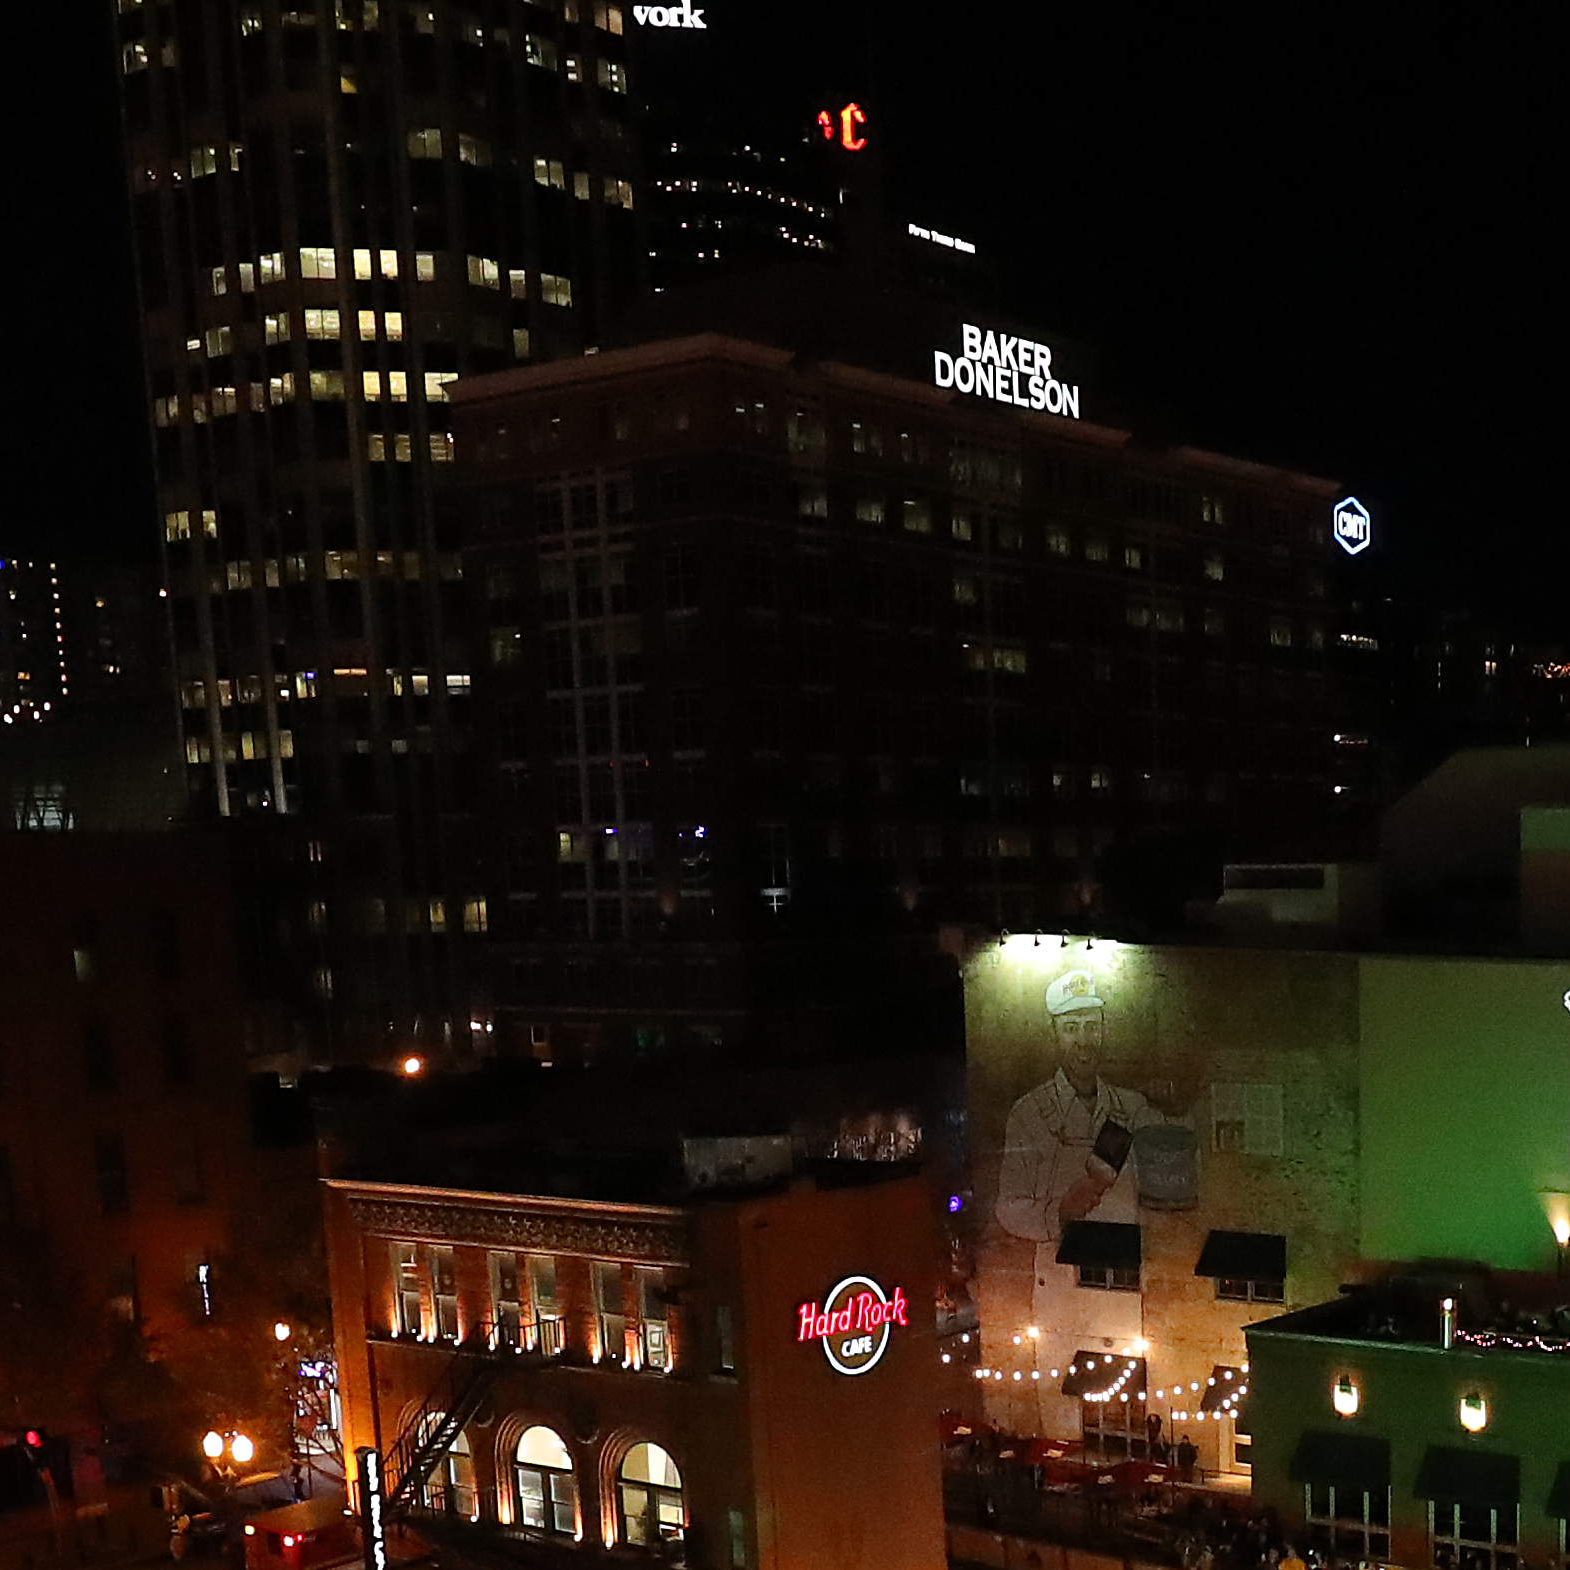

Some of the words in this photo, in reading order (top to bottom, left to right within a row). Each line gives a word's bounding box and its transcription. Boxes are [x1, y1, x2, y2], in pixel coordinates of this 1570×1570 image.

[962, 323, 1053, 380] BAKER
[934, 350, 1080, 419] DONELSON
[1338, 511, 1367, 540] CMT
[798, 1297, 853, 1342] Hard
[855, 1287, 910, 1332] Rock
[841, 1336, 873, 1358] CAFE
